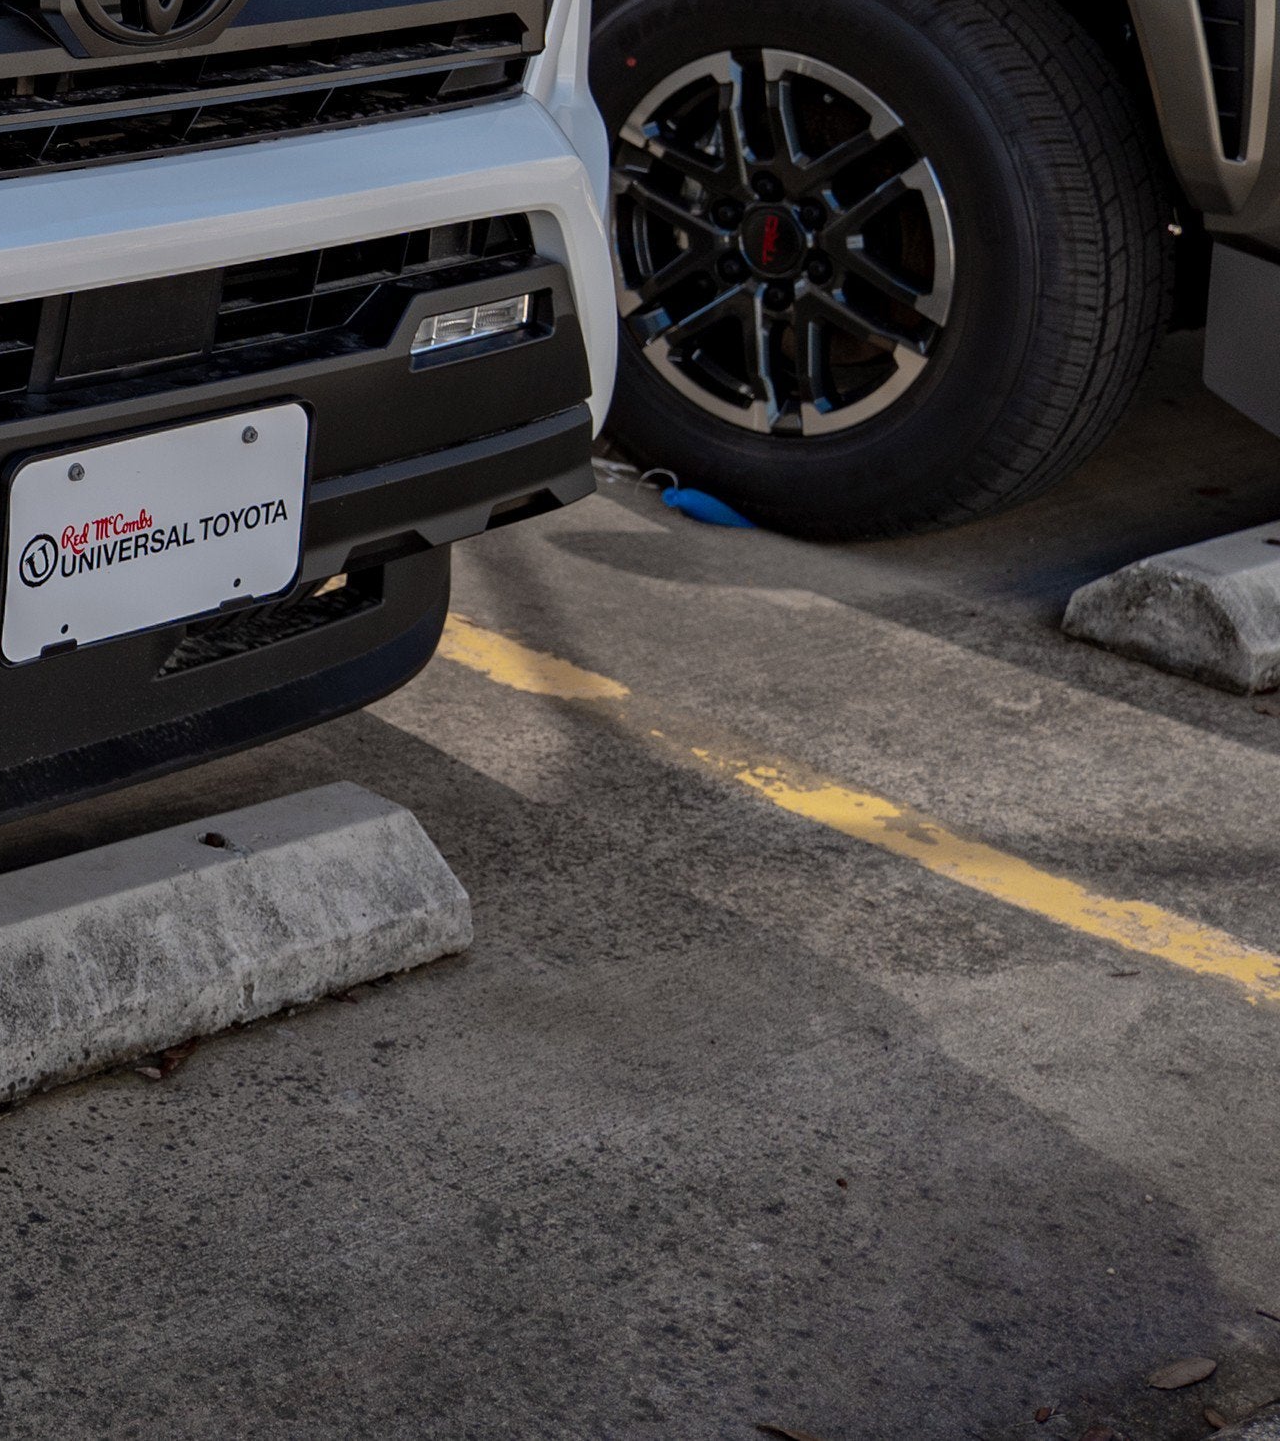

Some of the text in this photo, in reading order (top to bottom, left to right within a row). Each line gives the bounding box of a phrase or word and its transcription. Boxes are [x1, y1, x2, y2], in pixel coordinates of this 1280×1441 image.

[61, 499, 288, 578] UNIVERSAL TOYOTA
[61, 524, 89, 555] Red
